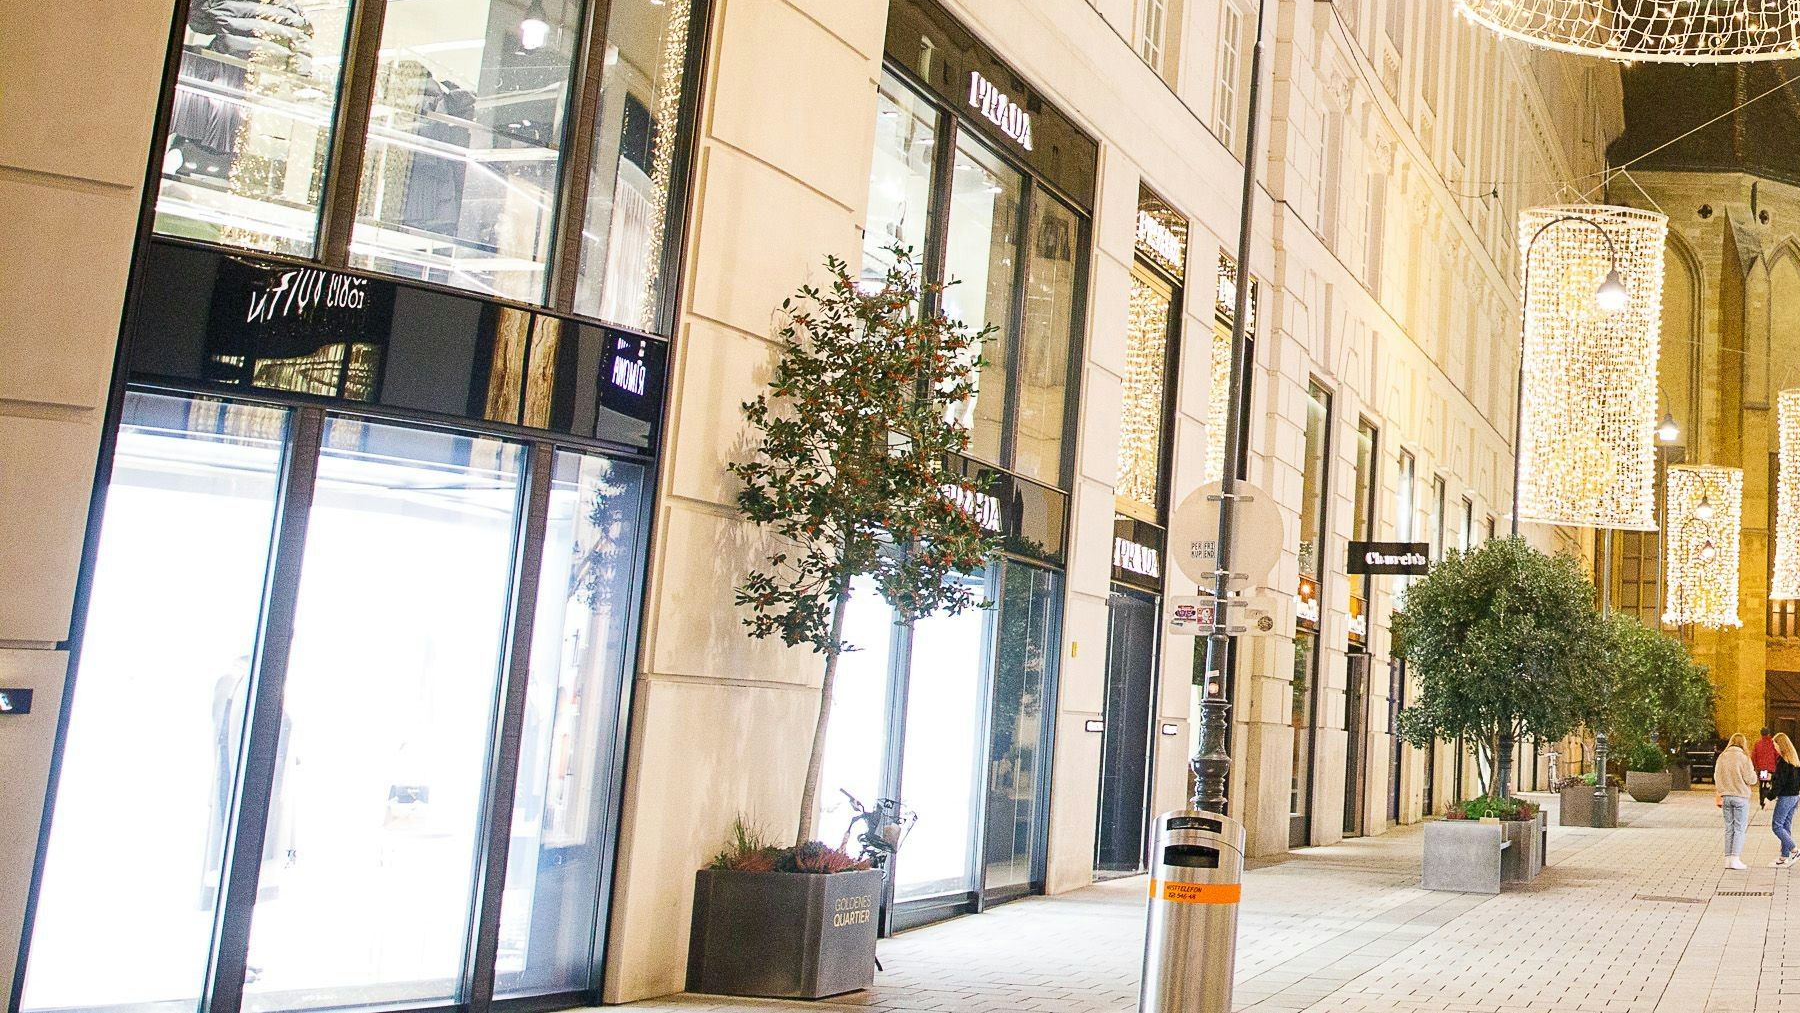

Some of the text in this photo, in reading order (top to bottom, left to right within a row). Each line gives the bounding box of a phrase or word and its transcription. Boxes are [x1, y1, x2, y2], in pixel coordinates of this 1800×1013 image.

[968, 71, 1033, 151] PRADA
[1365, 552, 1427, 565] Church's
[835, 895, 871, 911] GOLDENES
[833, 909, 870, 927] QUARTIER
